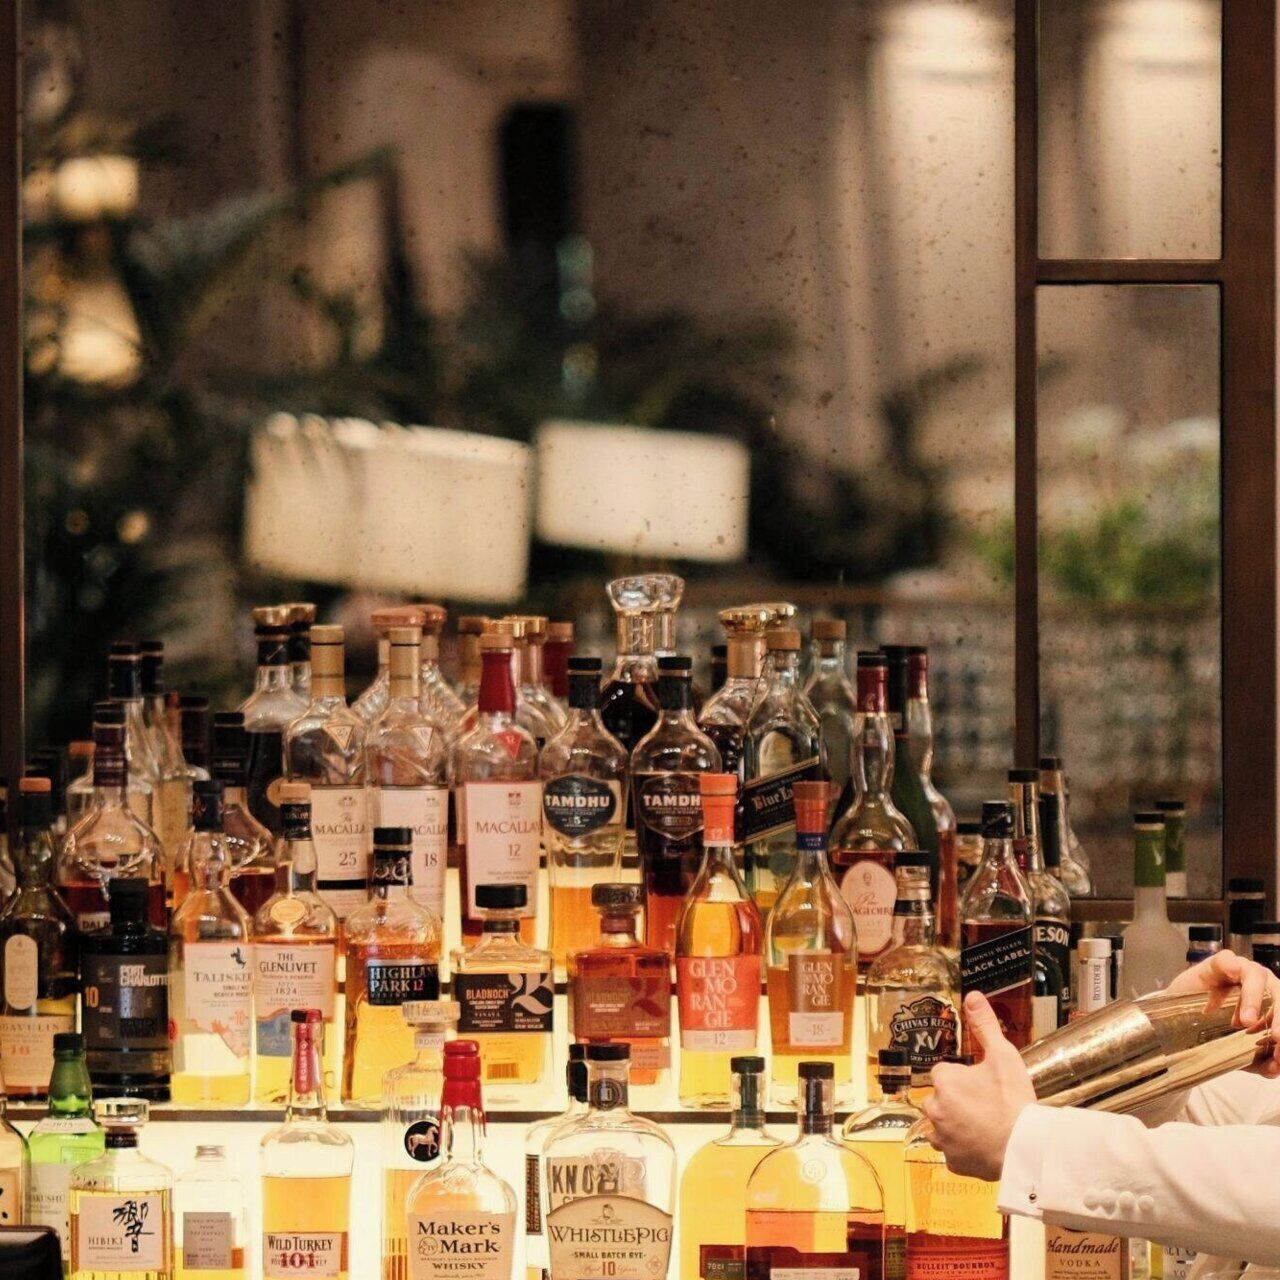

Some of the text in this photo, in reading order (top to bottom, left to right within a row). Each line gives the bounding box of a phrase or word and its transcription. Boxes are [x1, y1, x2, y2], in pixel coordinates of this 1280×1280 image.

[545, 794, 610, 807] TAMDHU
[642, 794, 701, 807] TAMDH
[507, 844, 522, 857] 12
[339, 851, 357, 866] 25
[424, 853, 438, 867] 18
[277, 952, 294, 962] THE
[962, 960, 996, 977] BLACK
[996, 949, 1031, 965] LABEL
[120, 964, 146, 976] PORT
[259, 961, 318, 974] GLENLIVET
[689, 959, 736, 979] GLEN
[801, 961, 833, 974] GLEN
[704, 977, 738, 994] MO
[814, 973, 834, 985] MO
[275, 987, 298, 996] 1824
[370, 979, 424, 993] PARK 12
[802, 984, 827, 996] RAN
[85, 986, 100, 1008] 10
[465, 988, 510, 1000] BLADNOCH
[691, 994, 726, 1011] RAN
[811, 995, 831, 1007] GIE
[704, 1010, 733, 1028] GIE
[893, 1017, 929, 1032] CHIVAS
[812, 1023, 825, 1036] 18
[714, 1032, 726, 1046] 12
[914, 1029, 943, 1054] XV
[30, 1195, 66, 1203] AKUSHU
[417, 1221, 501, 1236] Maker's
[547, 1224, 669, 1245] WHISTLEPIG
[88, 1237, 124, 1246] HIBIKI
[267, 1235, 334, 1252] WILD TURKEY
[439, 1239, 501, 1254] Mark
[1047, 1236, 1121, 1254] Handmade
[279, 1251, 316, 1269] 101
[601, 1251, 627, 1259] BATCH
[431, 1262, 488, 1270] WHISKY
[602, 1261, 616, 1276] 10
[916, 1261, 996, 1271] BULLEIT BOURBON
[1059, 1258, 1102, 1267] VODKA
